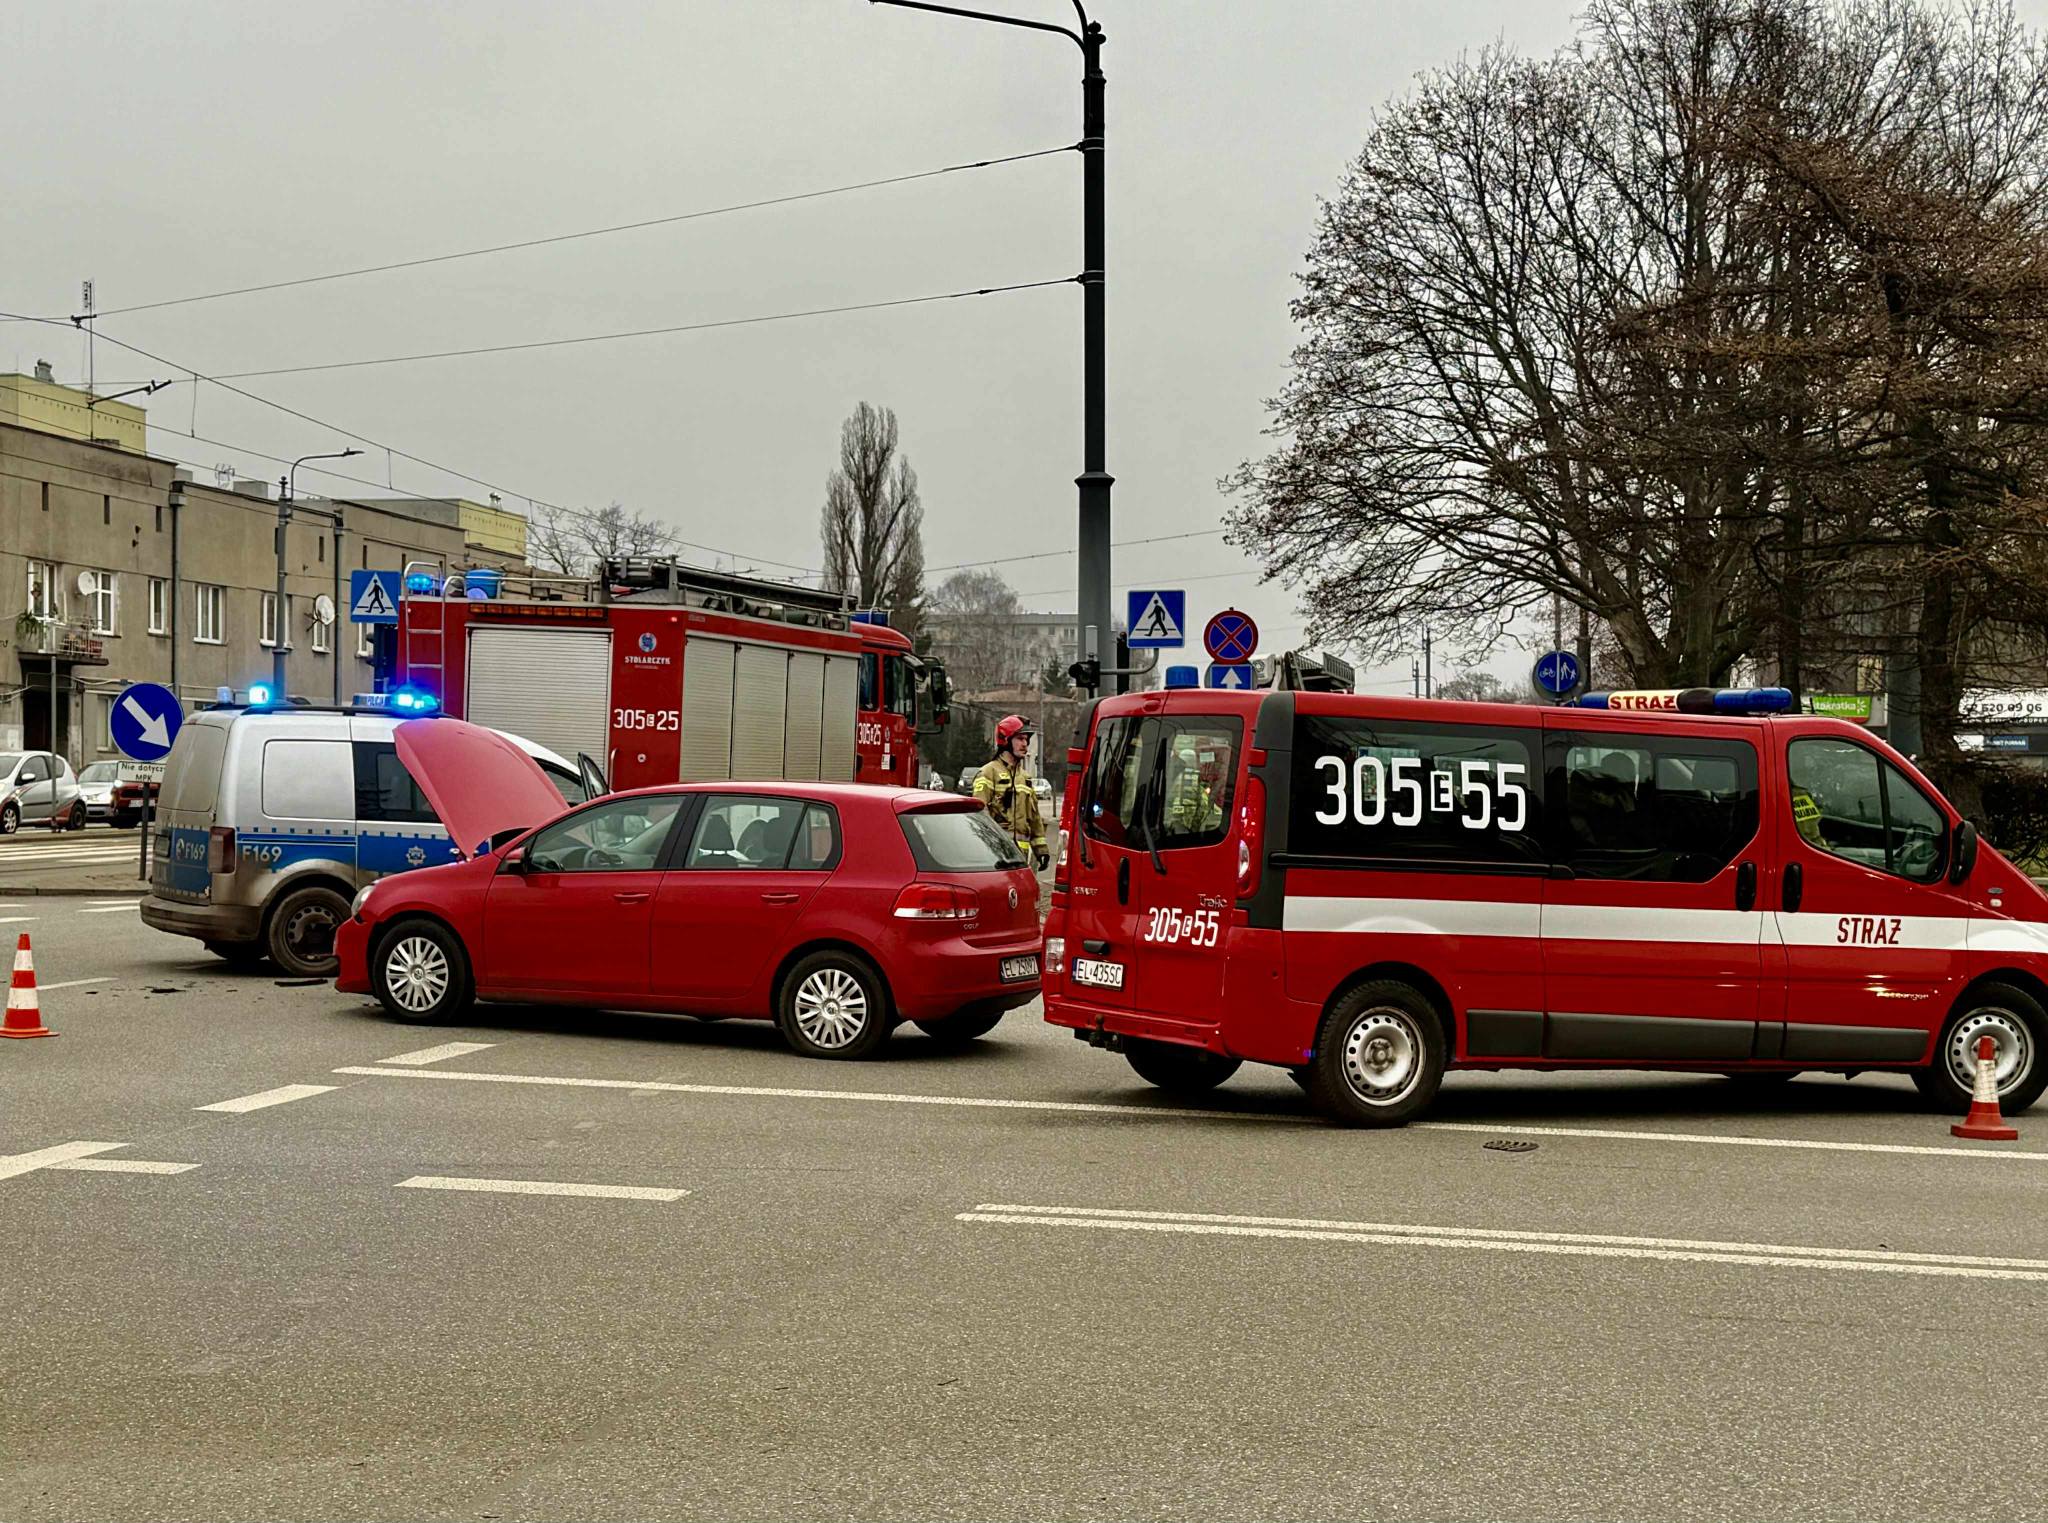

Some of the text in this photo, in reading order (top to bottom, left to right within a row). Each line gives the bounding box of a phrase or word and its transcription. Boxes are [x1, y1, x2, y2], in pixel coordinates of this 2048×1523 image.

[121, 762, 165, 774] Nie dotycz
[185, 841, 206, 860] F169
[242, 844, 282, 863] F169
